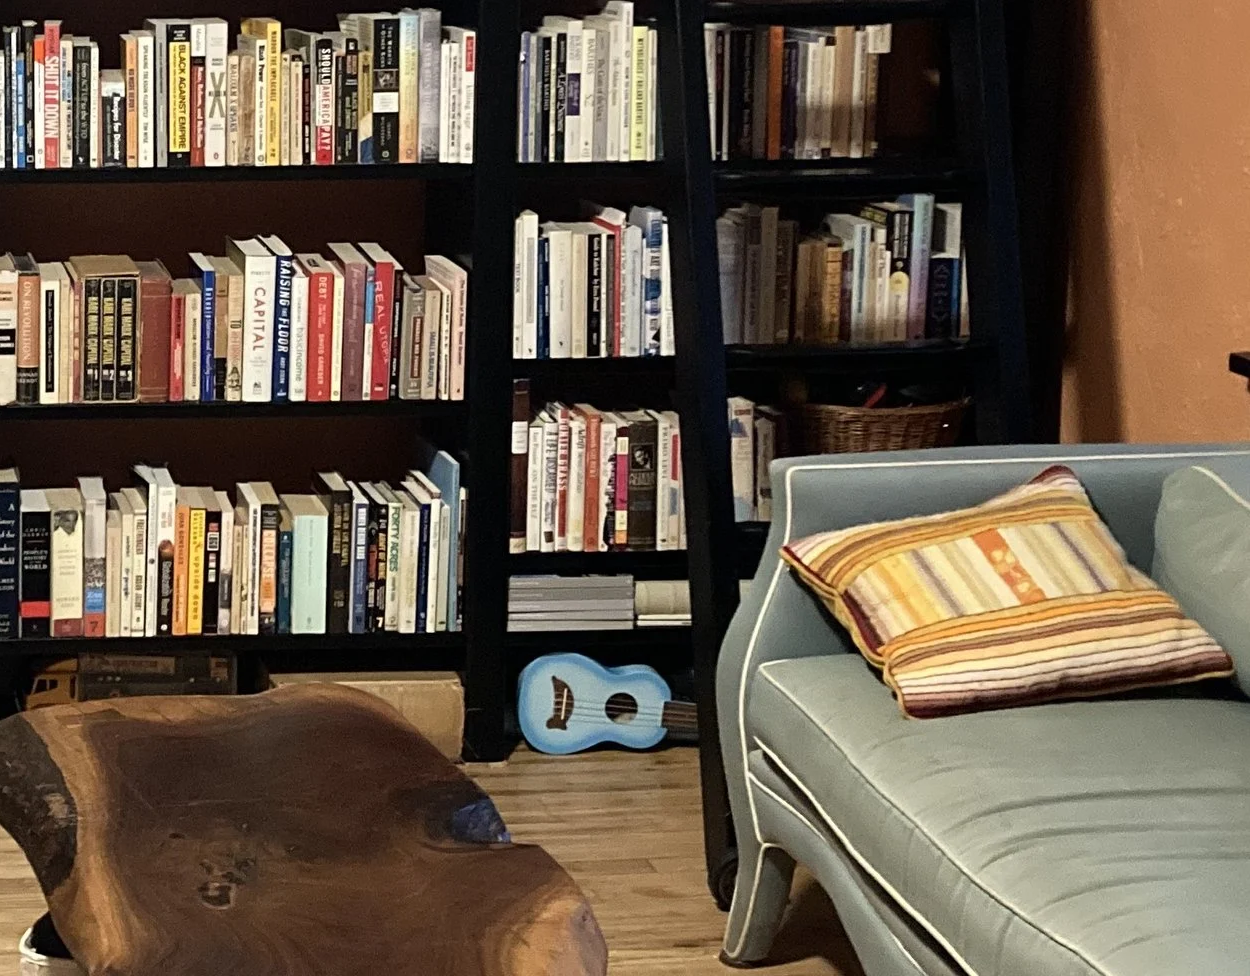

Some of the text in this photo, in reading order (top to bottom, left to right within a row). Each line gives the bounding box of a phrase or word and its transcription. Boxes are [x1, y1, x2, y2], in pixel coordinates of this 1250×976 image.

[45, 55, 59, 139] SHUT IT DOWN
[178, 44, 188, 150] BLACK AGAINST EMPIRE
[320, 48, 332, 152] SHOULD AMERICA PAY?
[278, 259, 292, 307] RAISING
[318, 276, 329, 300] DEBT
[22, 281, 34, 362] ON REVOLUTION
[87, 297, 98, 365] KARL MARX CAPITAL
[103, 297, 114, 365] KARL MARX CAPITAL
[120, 297, 132, 366] KARL MARX CAPITAL
[252, 286, 266, 352] CAPITAL
[277, 317, 290, 353] FLOOR
[317, 333, 325, 355] DAVID
[375, 280, 390, 365] REAL UTOPIA
[389, 507, 401, 572] FORTY ACRES
